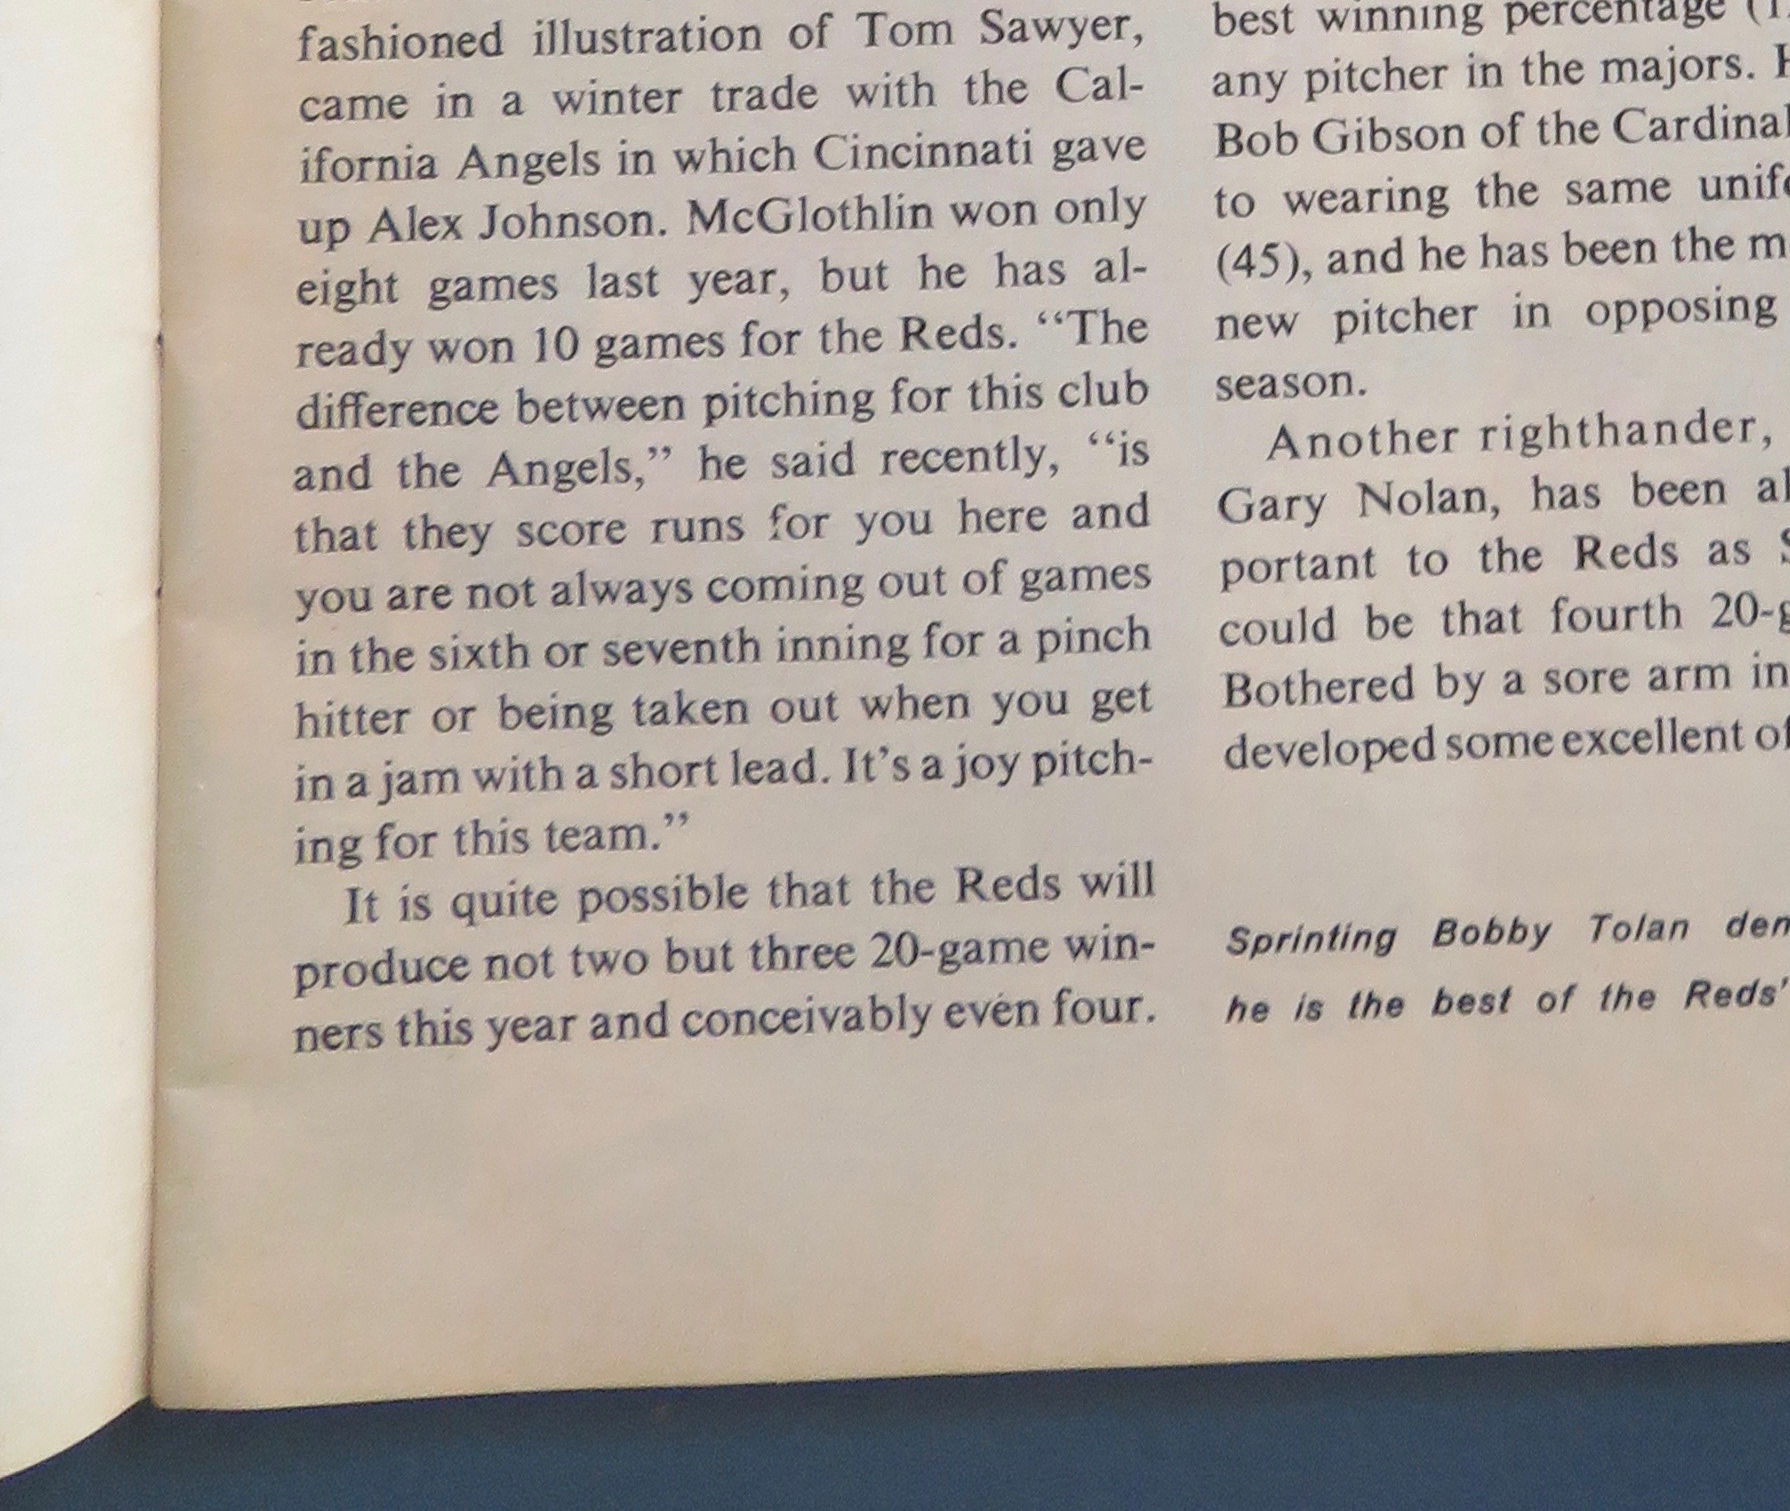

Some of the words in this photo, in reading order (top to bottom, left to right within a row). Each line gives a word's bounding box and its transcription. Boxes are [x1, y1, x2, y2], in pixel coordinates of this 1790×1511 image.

[1211, 0, 1296, 38] best
[297, 217, 352, 253] up
[367, 204, 464, 244] Alex
[478, 200, 667, 241] Johnson.
[687, 192, 934, 236] McGlothlin
[949, 199, 1038, 228] won
[1054, 185, 1148, 231] only
[296, 390, 500, 431] difference
[515, 386, 686, 425] between
[702, 379, 876, 429] pitching
[890, 375, 953, 415] for
[967, 371, 1045, 412] this
[1058, 367, 1150, 409] club
[1215, 370, 1367, 402] season.
[1266, 418, 1460, 461] Another
[1479, 406, 1772, 459] righthander,
[1219, 604, 1337, 648] could
[1364, 602, 1414, 641] be
[1441, 598, 1523, 638] that
[1550, 592, 1683, 634] fourth
[1224, 723, 1437, 774] developed
[1445, 730, 1554, 761] some
[1561, 715, 1745, 758] excellent
[1225, 922, 1398, 961] Sprinting
[1432, 915, 1553, 952] Bobby
[1590, 912, 1690, 943] Tolan
[293, 1022, 385, 1054] ners
[396, 1007, 474, 1048] this
[485, 1014, 579, 1053] year
[589, 999, 670, 1041] and
[681, 992, 933, 1039] conceivably
[944, 999, 1040, 1030] even
[1053, 986, 1156, 1027] four.
[1225, 994, 1271, 1024] he
[1294, 992, 1325, 1023] is
[1348, 989, 1406, 1020] the
[1431, 985, 1513, 1017] best
[1536, 983, 1578, 1015] of
[1600, 982, 1657, 1012] the
[1684, 976, 1790, 1010] Reds'
